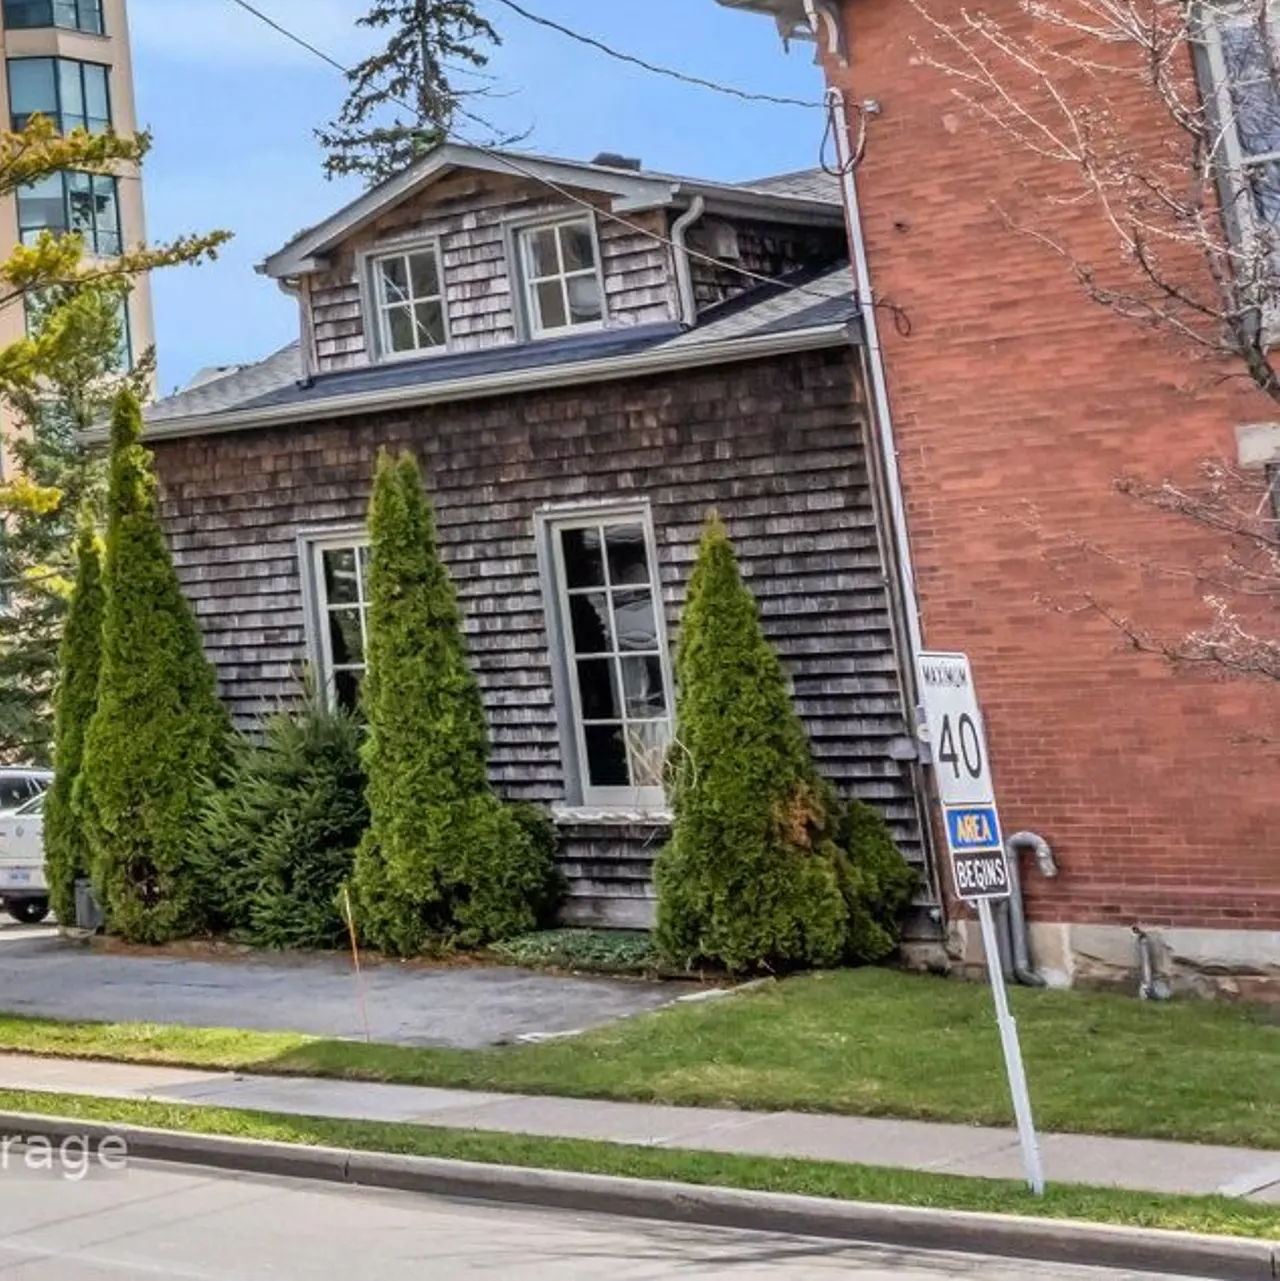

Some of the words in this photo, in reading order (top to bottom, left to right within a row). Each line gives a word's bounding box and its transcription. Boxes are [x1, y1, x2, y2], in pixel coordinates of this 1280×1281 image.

[938, 712, 982, 779] 40
[956, 814, 993, 842] AREA
[957, 859, 1006, 890] BEGINS
